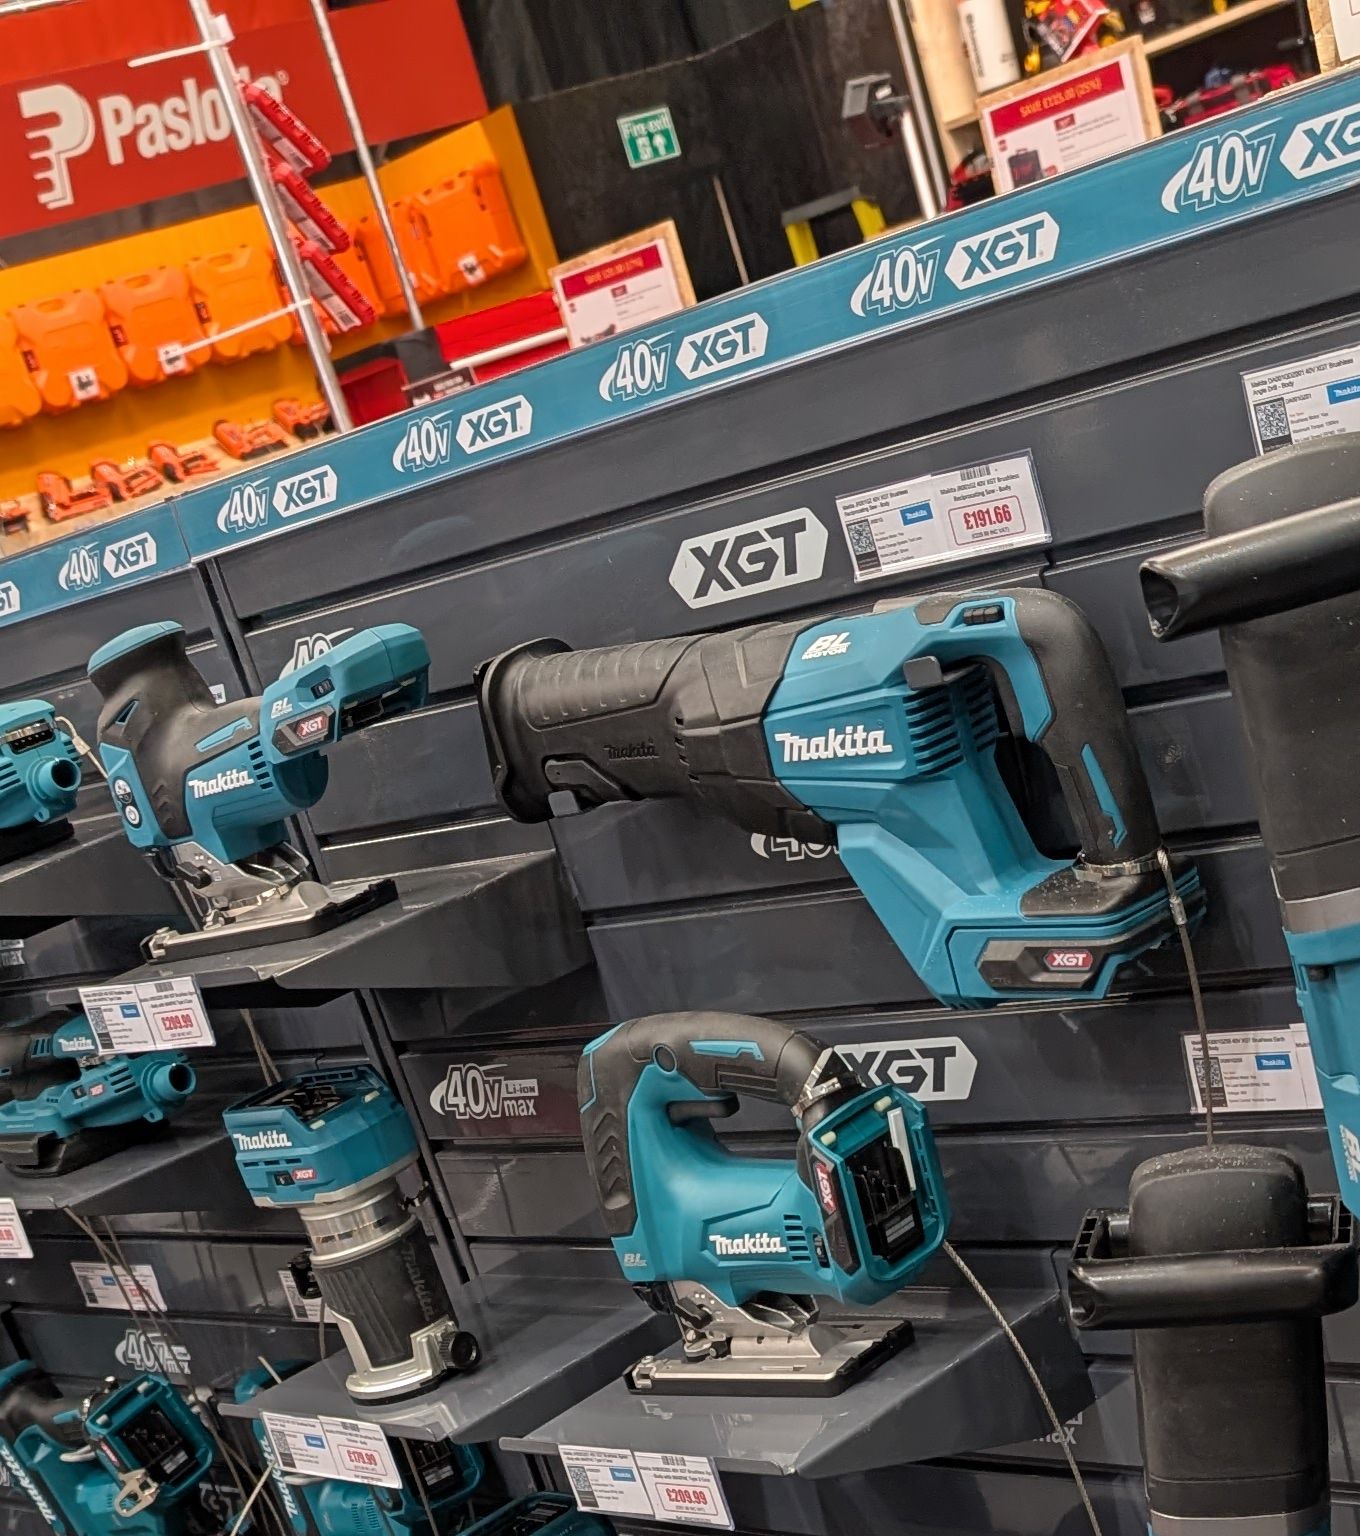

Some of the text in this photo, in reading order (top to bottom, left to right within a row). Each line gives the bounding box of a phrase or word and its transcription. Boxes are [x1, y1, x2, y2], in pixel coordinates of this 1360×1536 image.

[99, 74, 282, 166] Paslo
[960, 219, 1047, 282] XGT
[688, 323, 756, 373] XGT
[466, 401, 524, 448] XGT
[281, 470, 329, 513] XGT
[963, 503, 1013, 531] £191.66
[108, 537, 149, 573] XGT
[688, 517, 809, 600] XGT
[806, 632, 851, 651] BL
[299, 716, 325, 736] XGT
[1052, 951, 1088, 968] XGT
[846, 1042, 958, 1094] XGT
[503, 1100, 537, 1118] max
[505, 1085, 537, 1096] Li-ion
[293, 1168, 315, 1180] XGT
[817, 1163, 836, 1207] XGT
